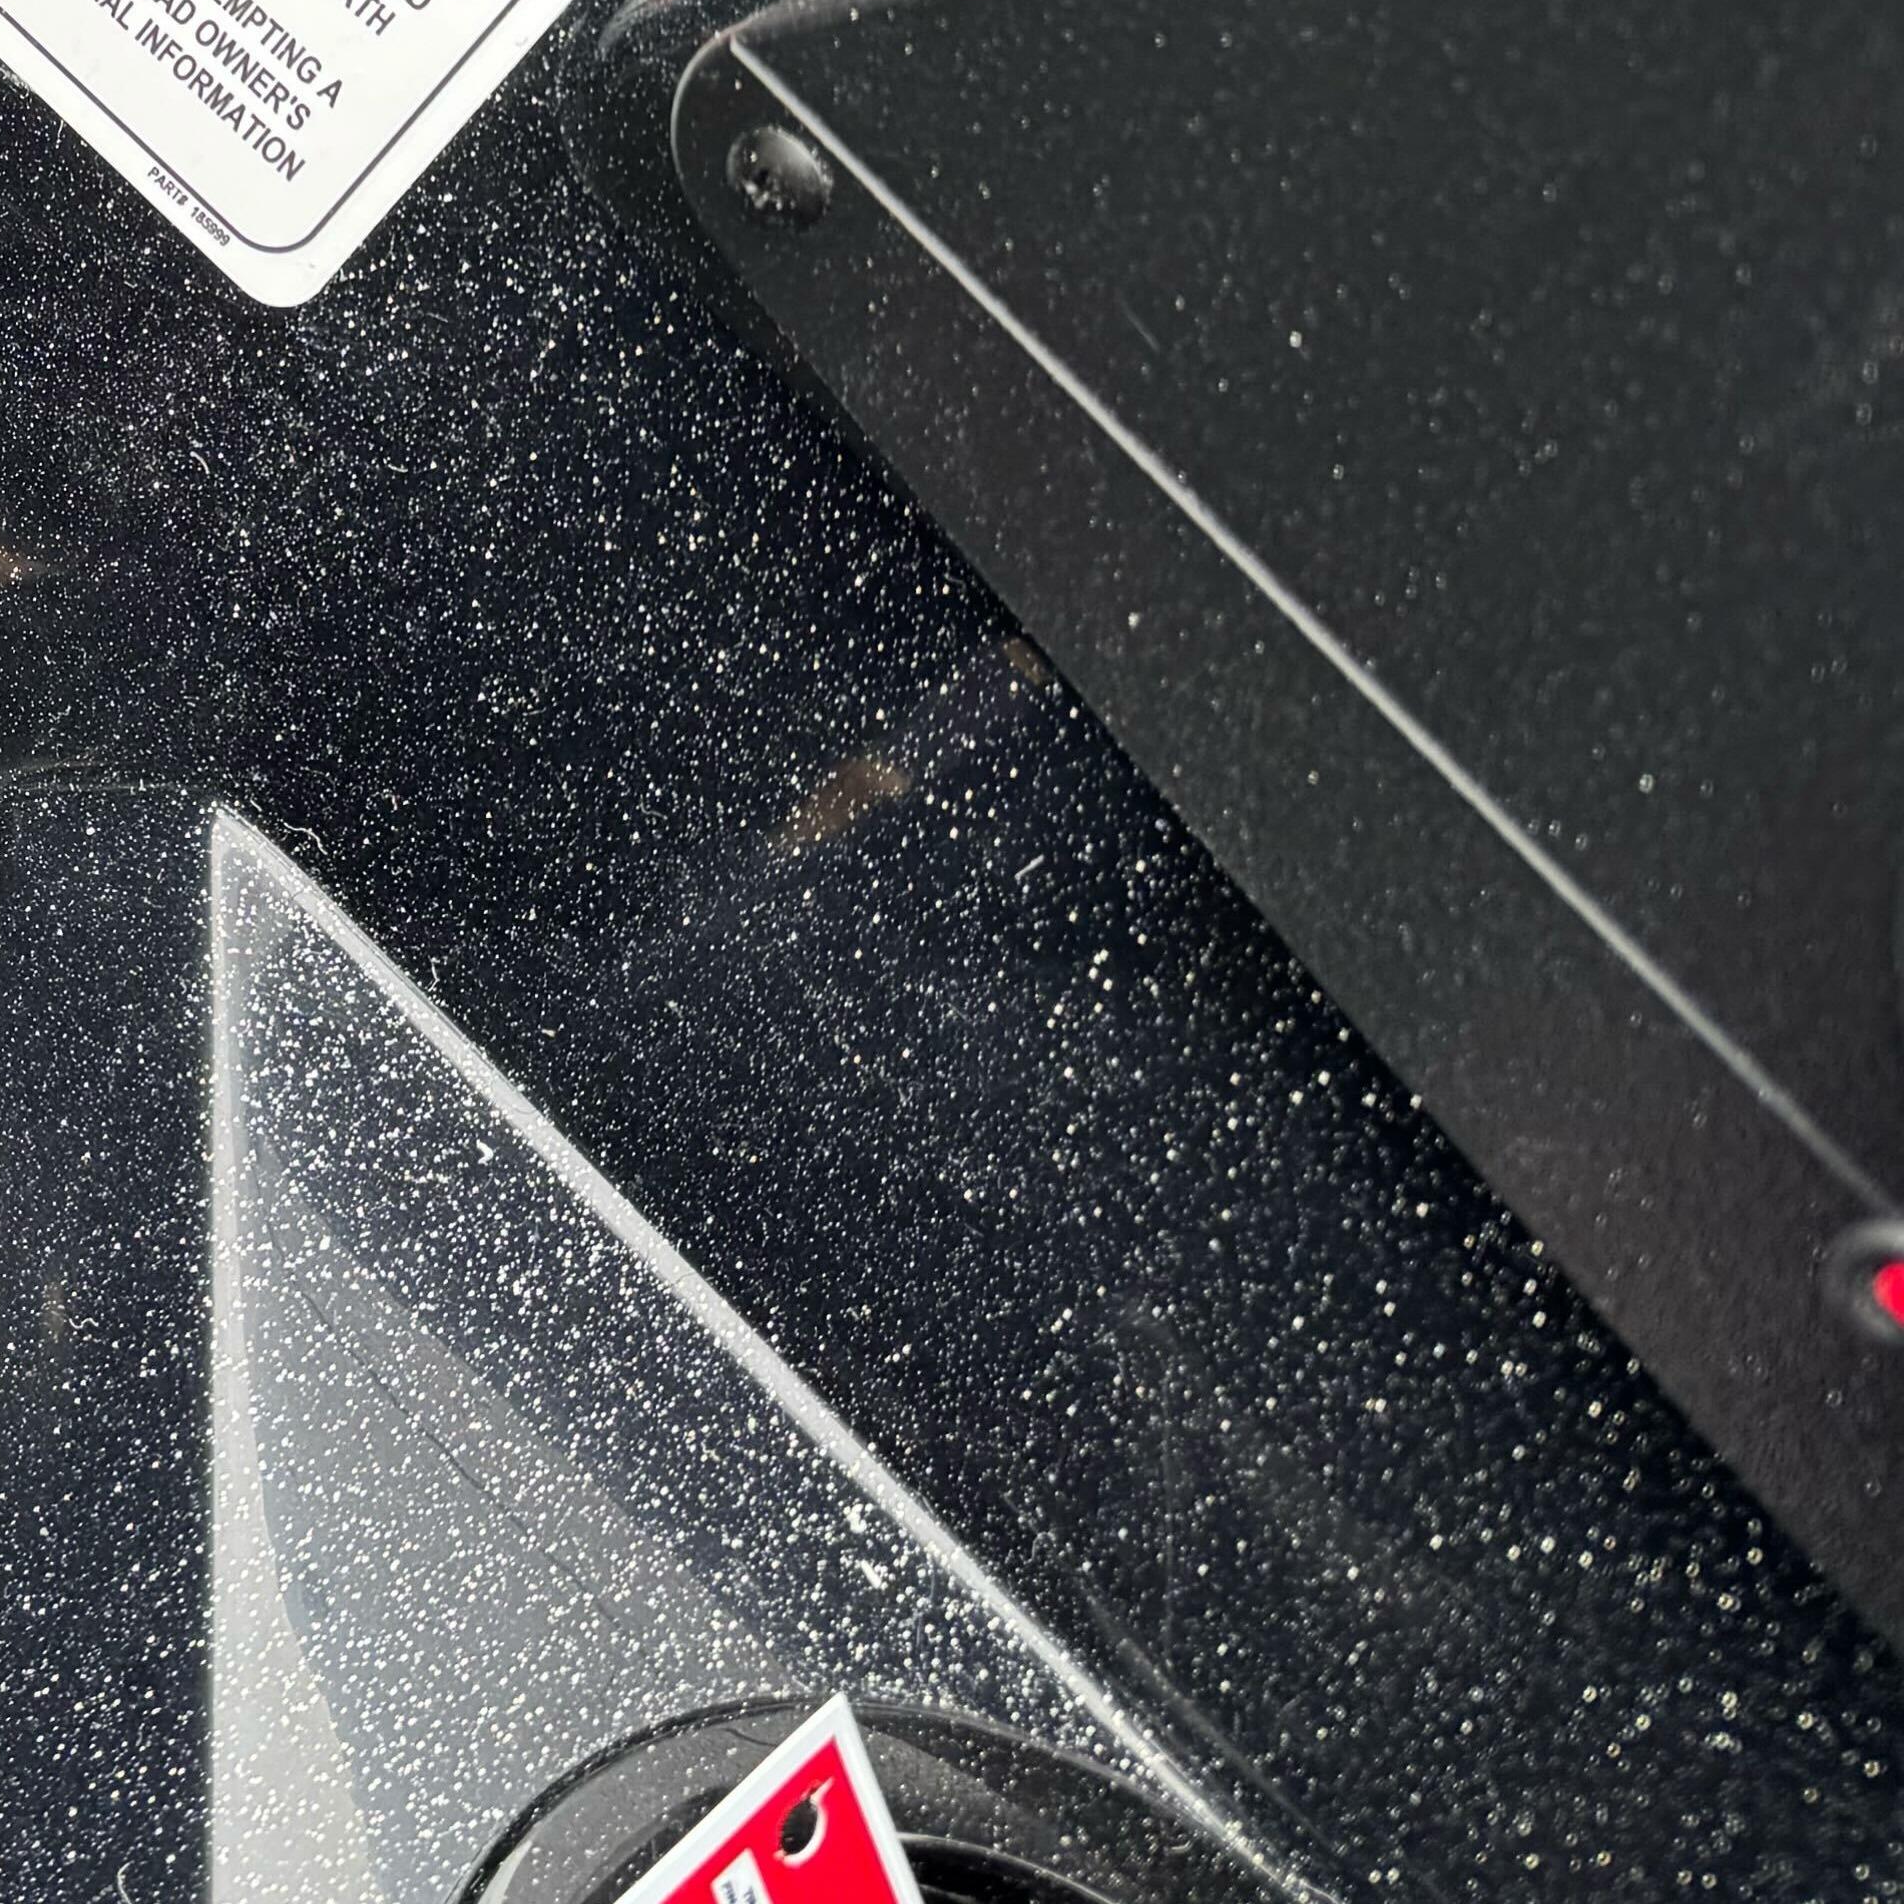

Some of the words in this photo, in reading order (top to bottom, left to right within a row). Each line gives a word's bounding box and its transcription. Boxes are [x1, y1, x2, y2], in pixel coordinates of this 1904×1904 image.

[133, 17, 307, 183] INFORMATION
[193, 18, 312, 132] OWNER'S
[315, 78, 344, 110] A
[189, 205, 232, 248] 185999
